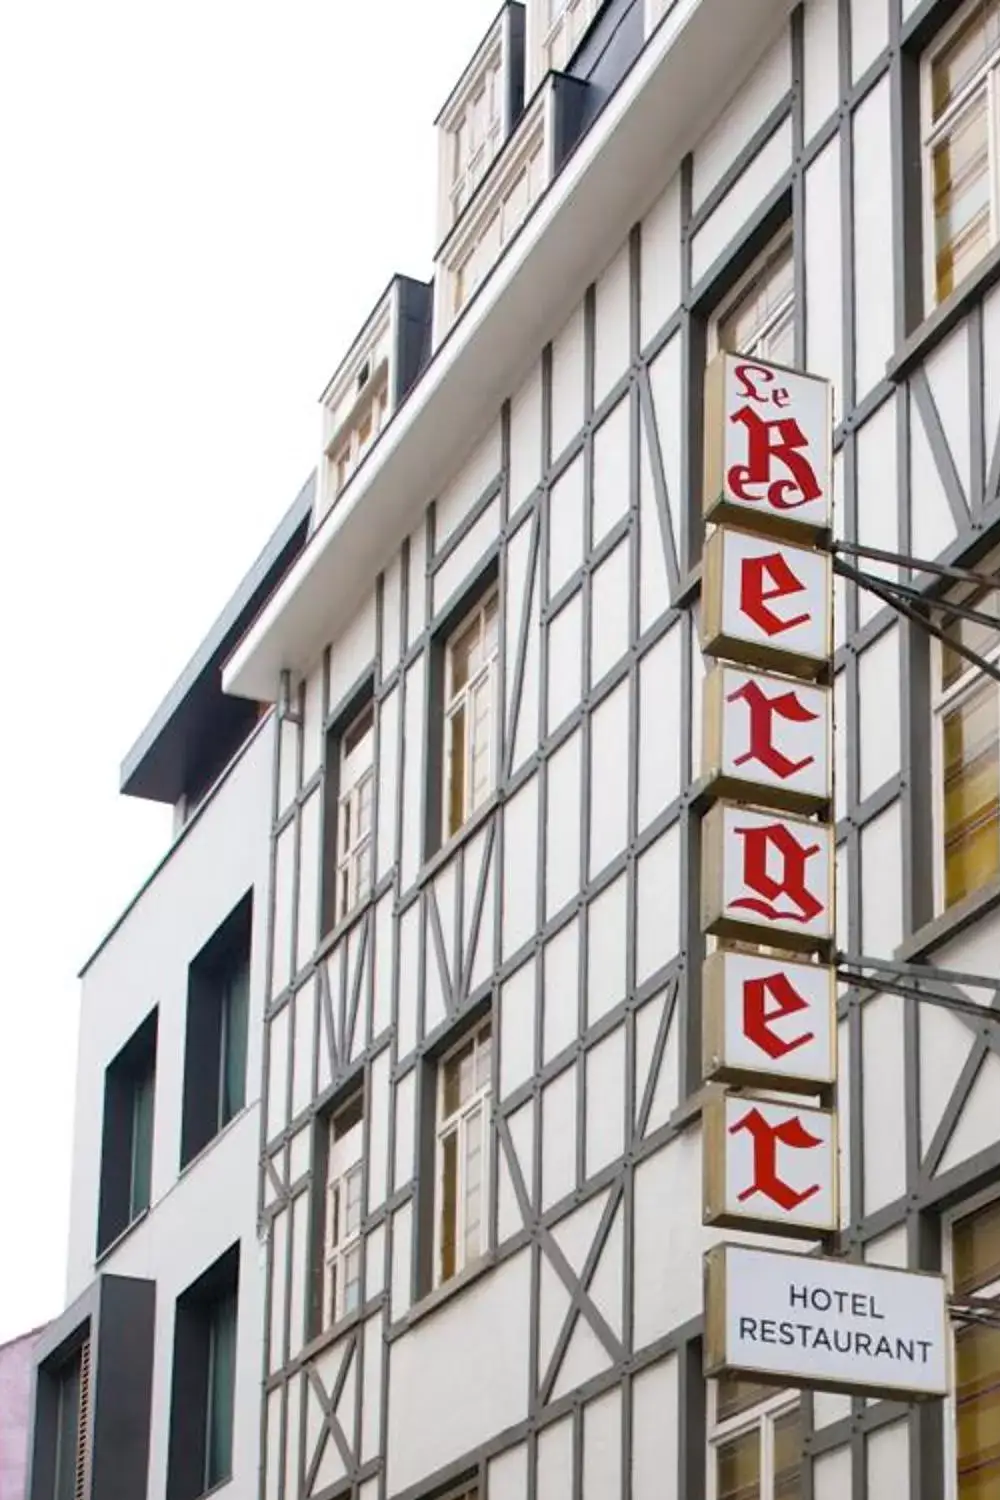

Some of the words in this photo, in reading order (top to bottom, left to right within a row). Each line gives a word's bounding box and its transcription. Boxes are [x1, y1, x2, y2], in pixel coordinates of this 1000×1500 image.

[734, 364, 790, 408] Le
[789, 1284, 885, 1320] HOTEL
[739, 1317, 933, 1363] RESTAURANT
